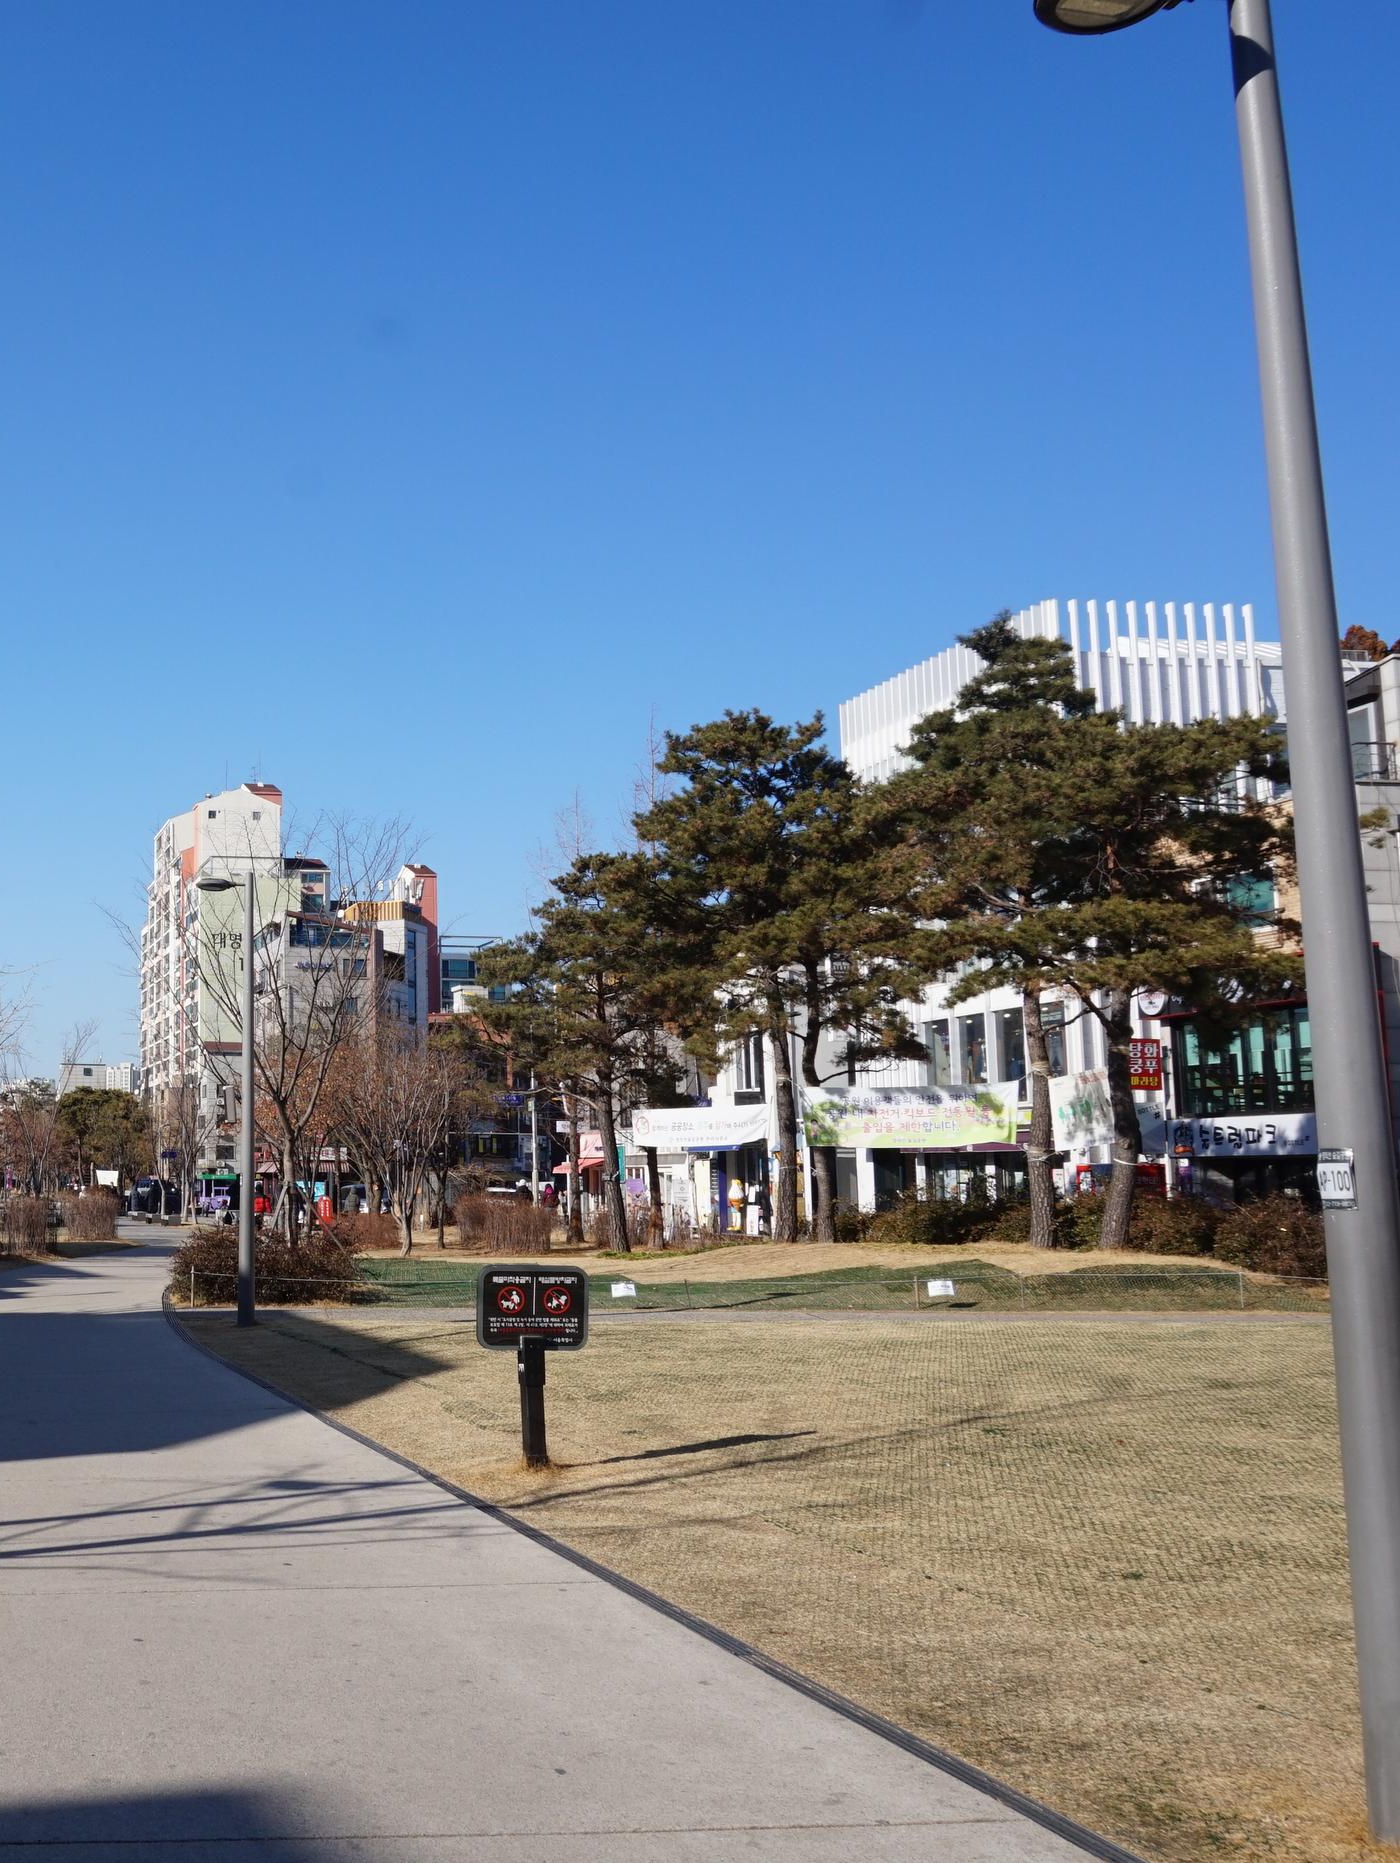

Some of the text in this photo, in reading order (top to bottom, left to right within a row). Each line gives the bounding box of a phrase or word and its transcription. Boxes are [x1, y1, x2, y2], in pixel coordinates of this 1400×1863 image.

[212, 932, 242, 950] 대명
[1129, 1042, 1159, 1058] 탕화
[1129, 1058, 1159, 1074] 쿵푸
[1130, 1076, 1159, 1086] 마라탕
